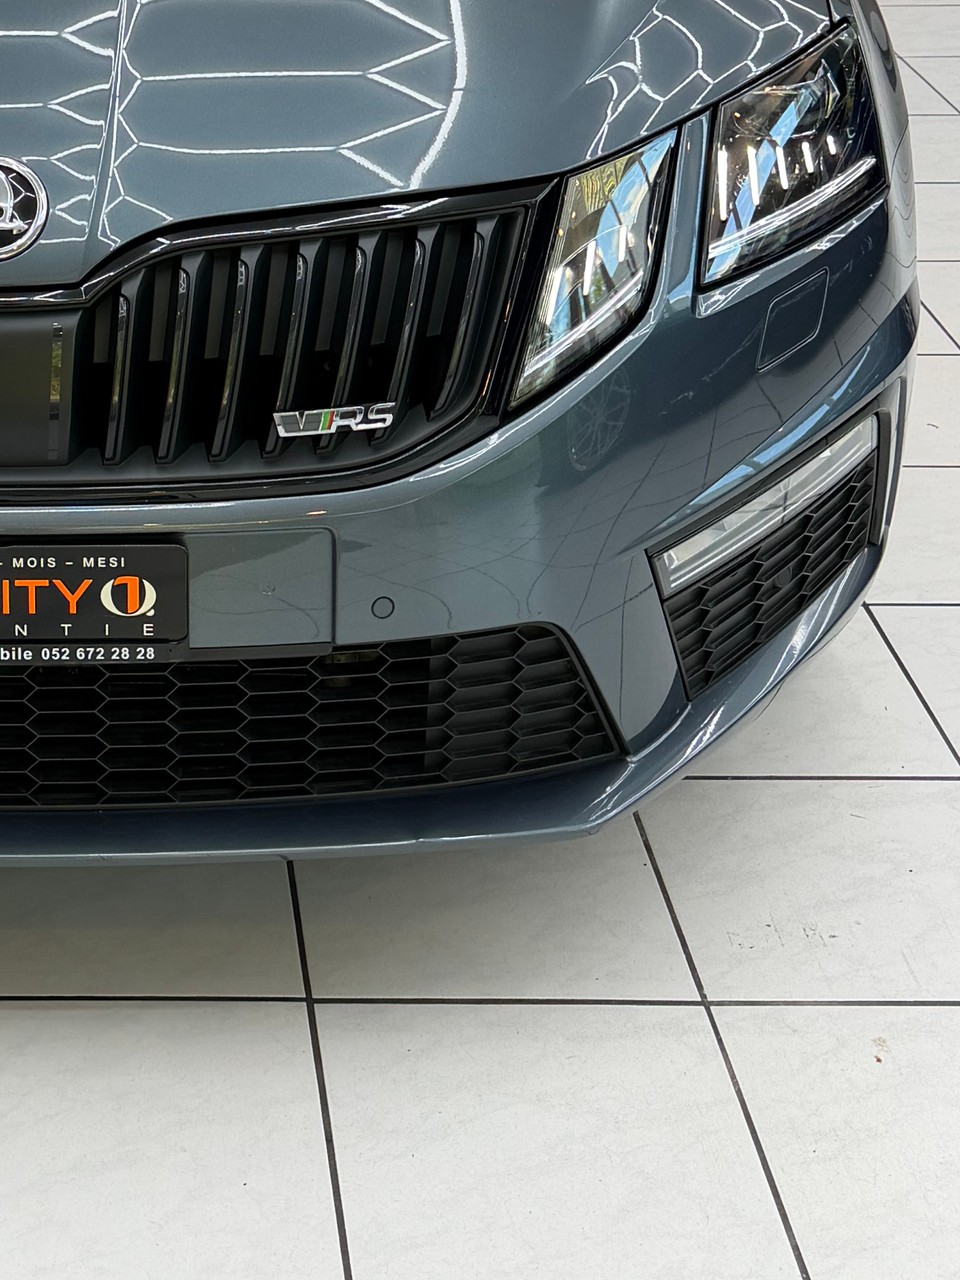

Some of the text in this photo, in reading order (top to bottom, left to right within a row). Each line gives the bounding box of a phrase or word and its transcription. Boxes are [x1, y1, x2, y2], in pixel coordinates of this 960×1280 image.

[12, 557, 56, 568] MOIS
[83, 557, 125, 568] MESI
[41, 647, 70, 660] 052
[76, 647, 105, 660] 672
[111, 647, 130, 660] 28
[136, 647, 155, 660] 28
